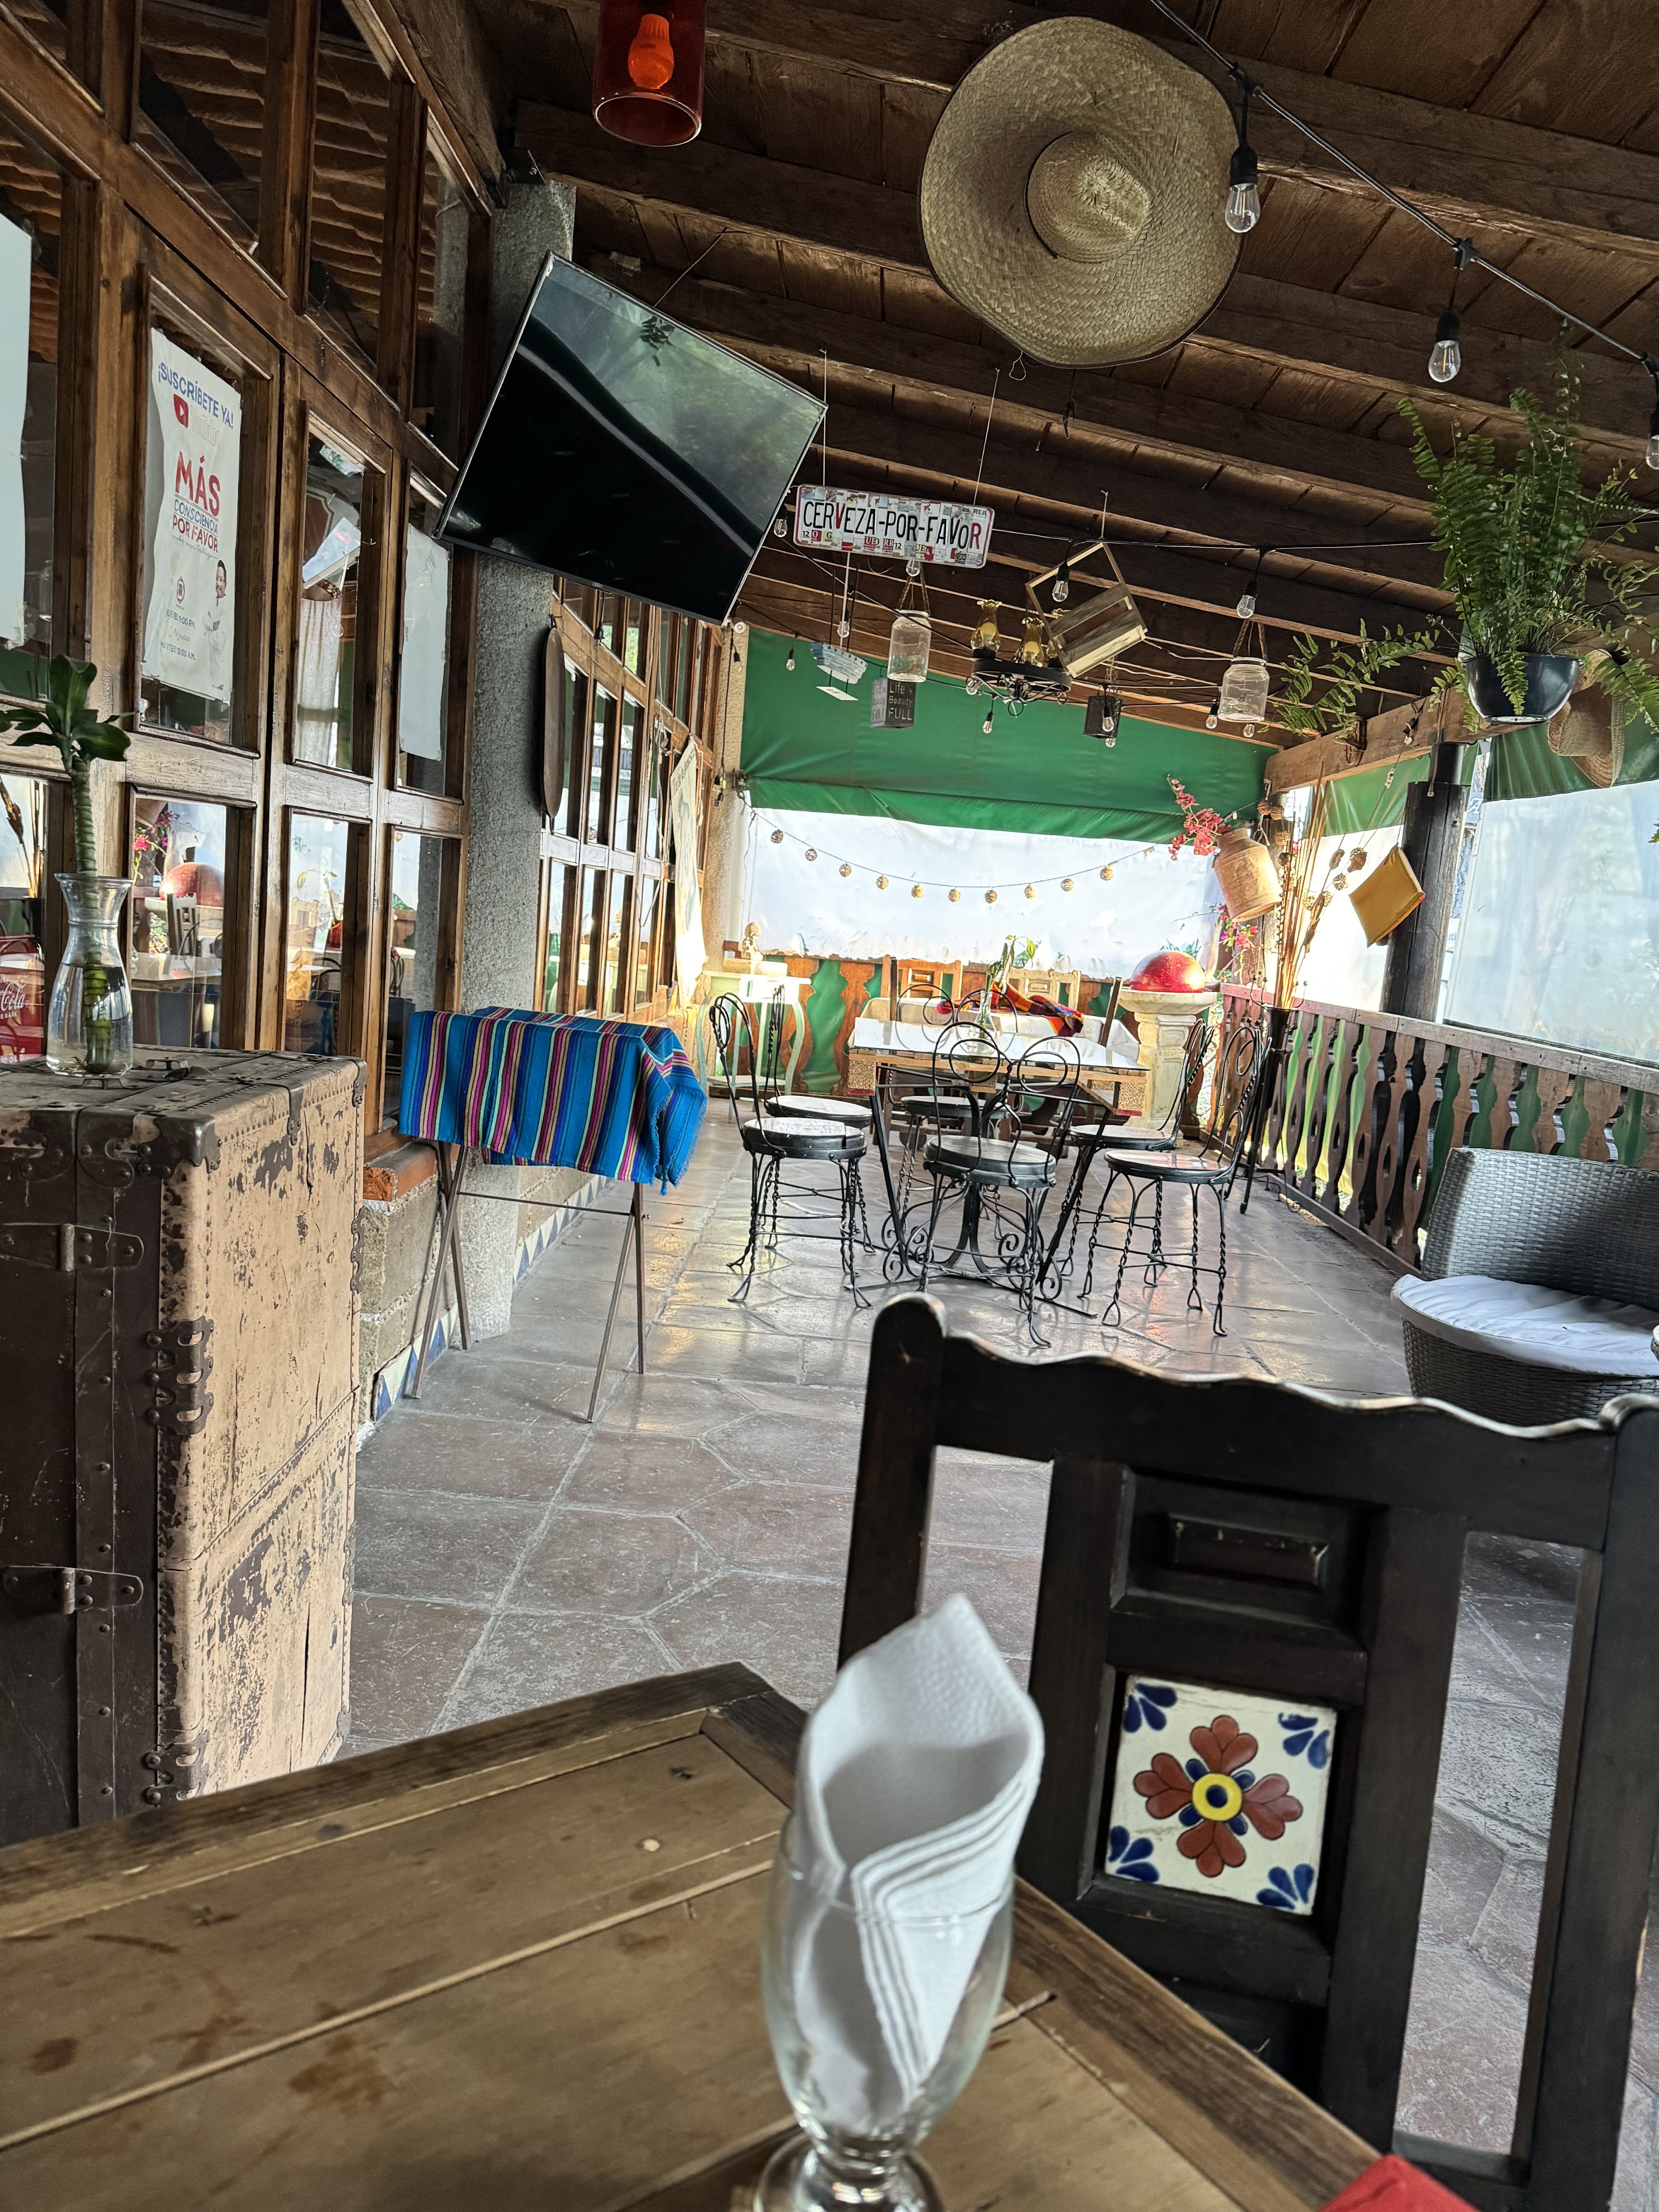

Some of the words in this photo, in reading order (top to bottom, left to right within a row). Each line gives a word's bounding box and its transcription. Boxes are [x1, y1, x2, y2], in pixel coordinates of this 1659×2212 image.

[190, 406, 220, 449] YouTube
[221, 405, 233, 429] YA!
[175, 451, 221, 517] MÁS
[174, 499, 218, 535] CONSCIENCIA
[172, 514, 190, 538] POR
[191, 524, 218, 553] FAVOR
[889, 695, 912, 708] Beauty
[890, 682, 905, 694] Life
[888, 707, 912, 720] FULL
